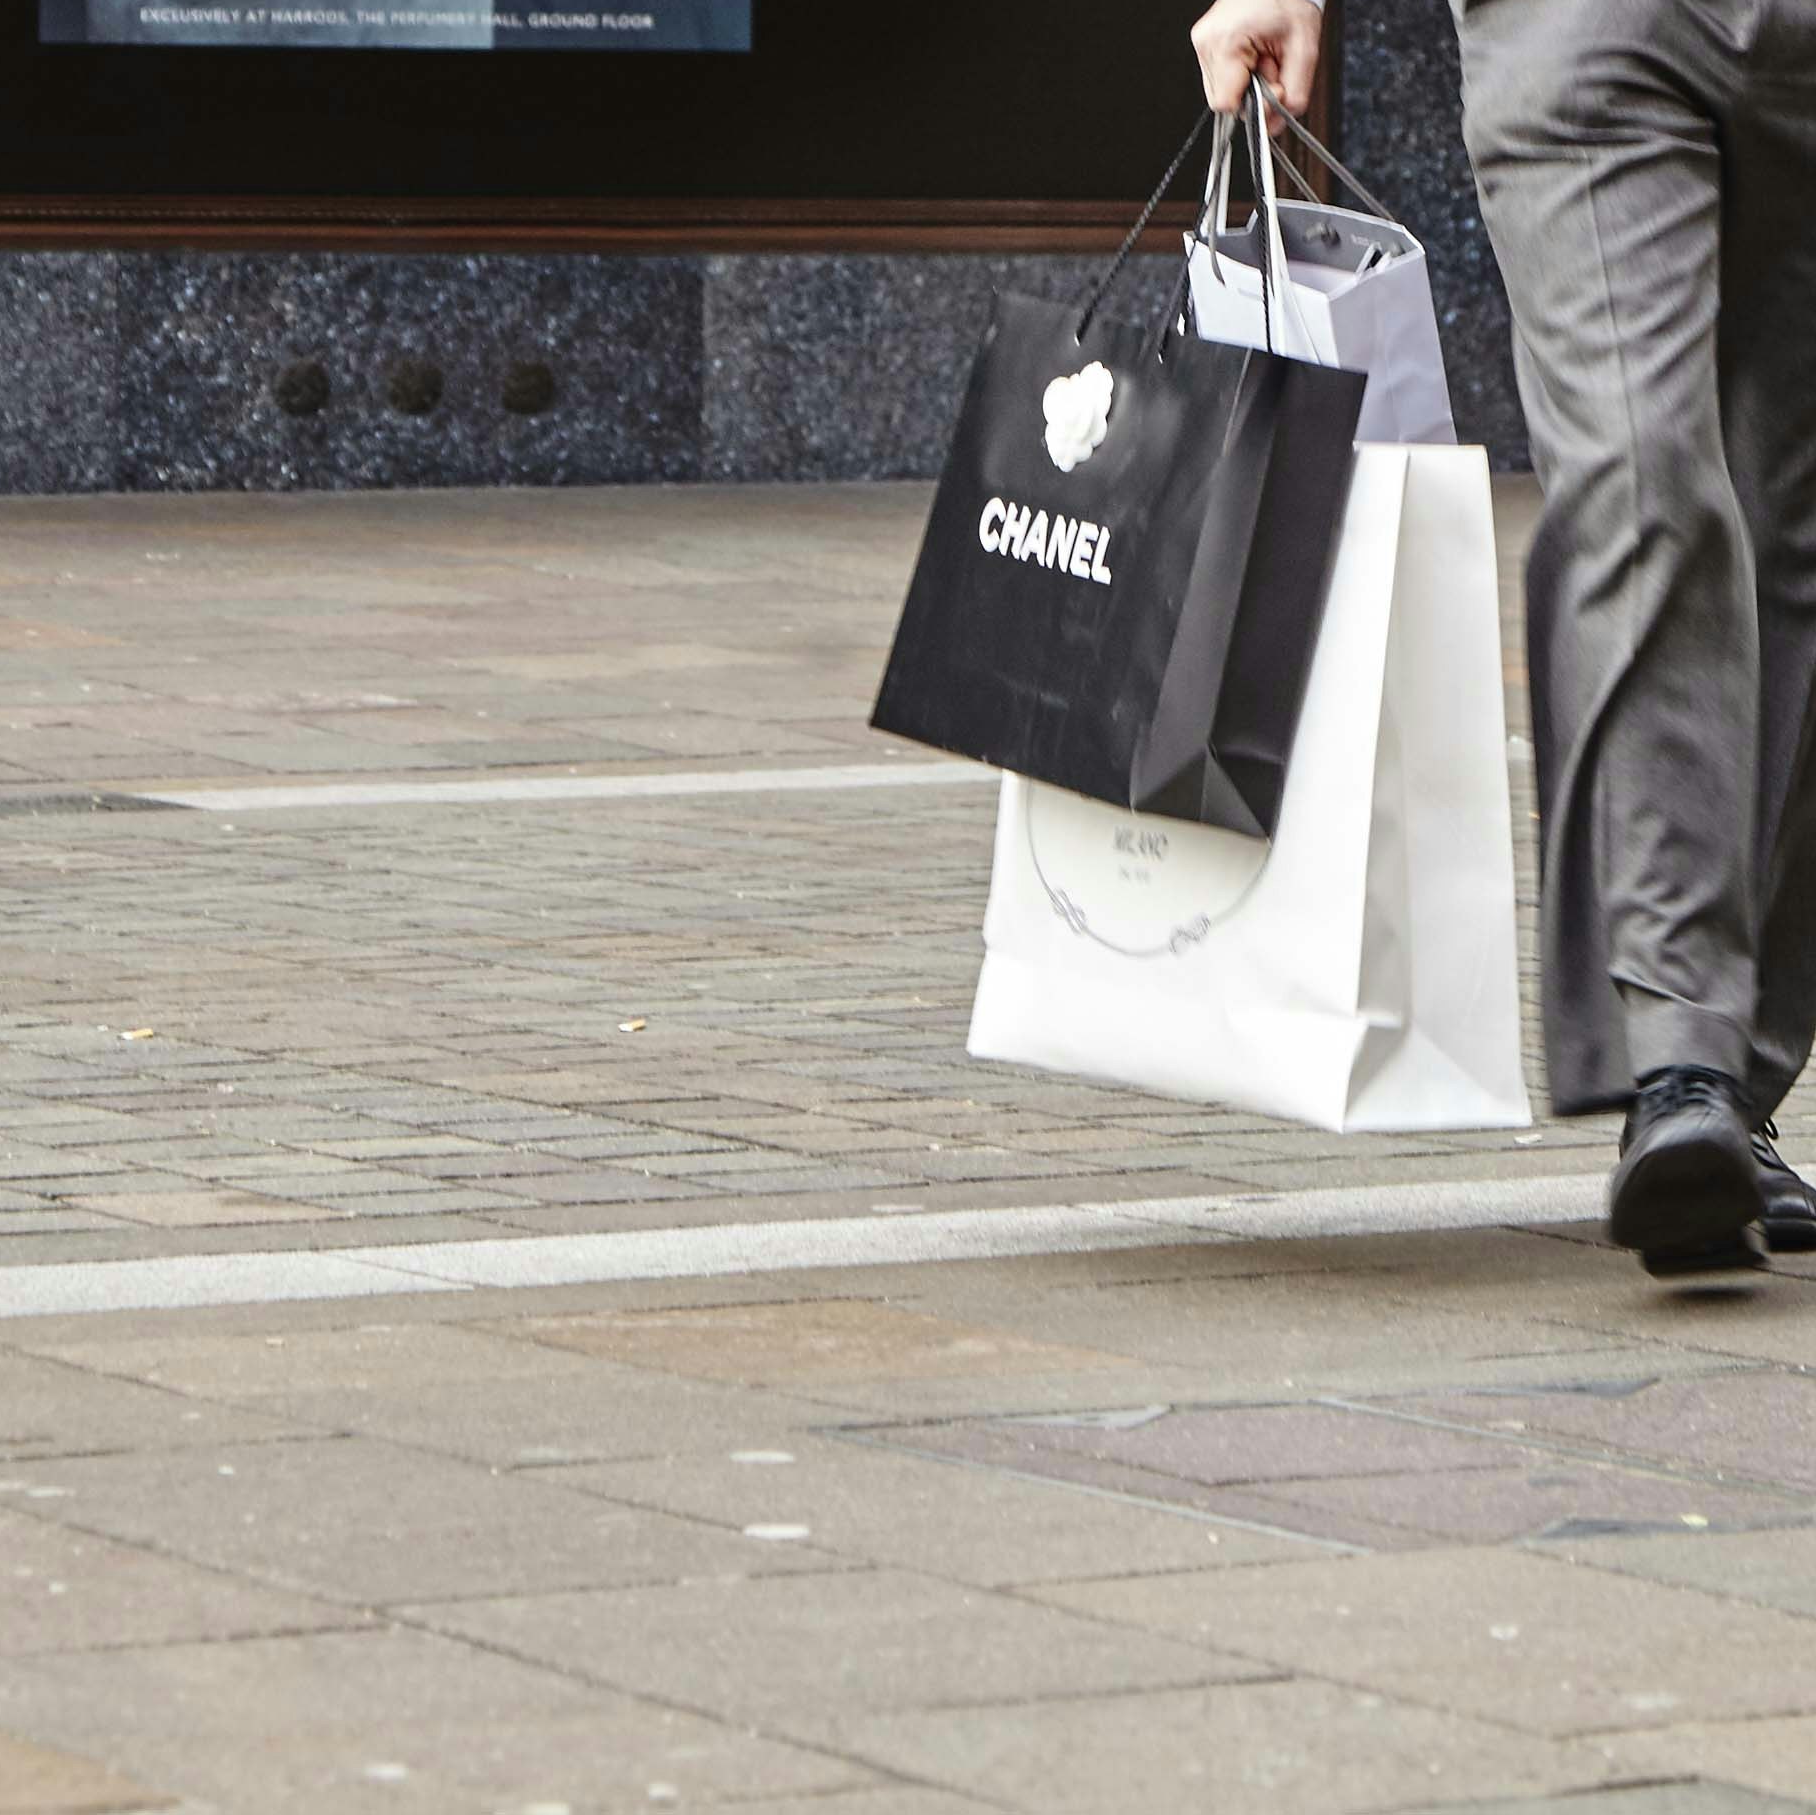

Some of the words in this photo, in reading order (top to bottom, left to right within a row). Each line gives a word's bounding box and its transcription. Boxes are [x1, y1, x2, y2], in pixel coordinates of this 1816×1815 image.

[140, 8, 239, 24] EXCLUSIVELY
[245, 9, 266, 24] AT
[356, 10, 385, 25] THE
[528, 12, 597, 29] GROUND
[602, 13, 654, 29] FLOOR
[978, 496, 1113, 586] CHANEL
